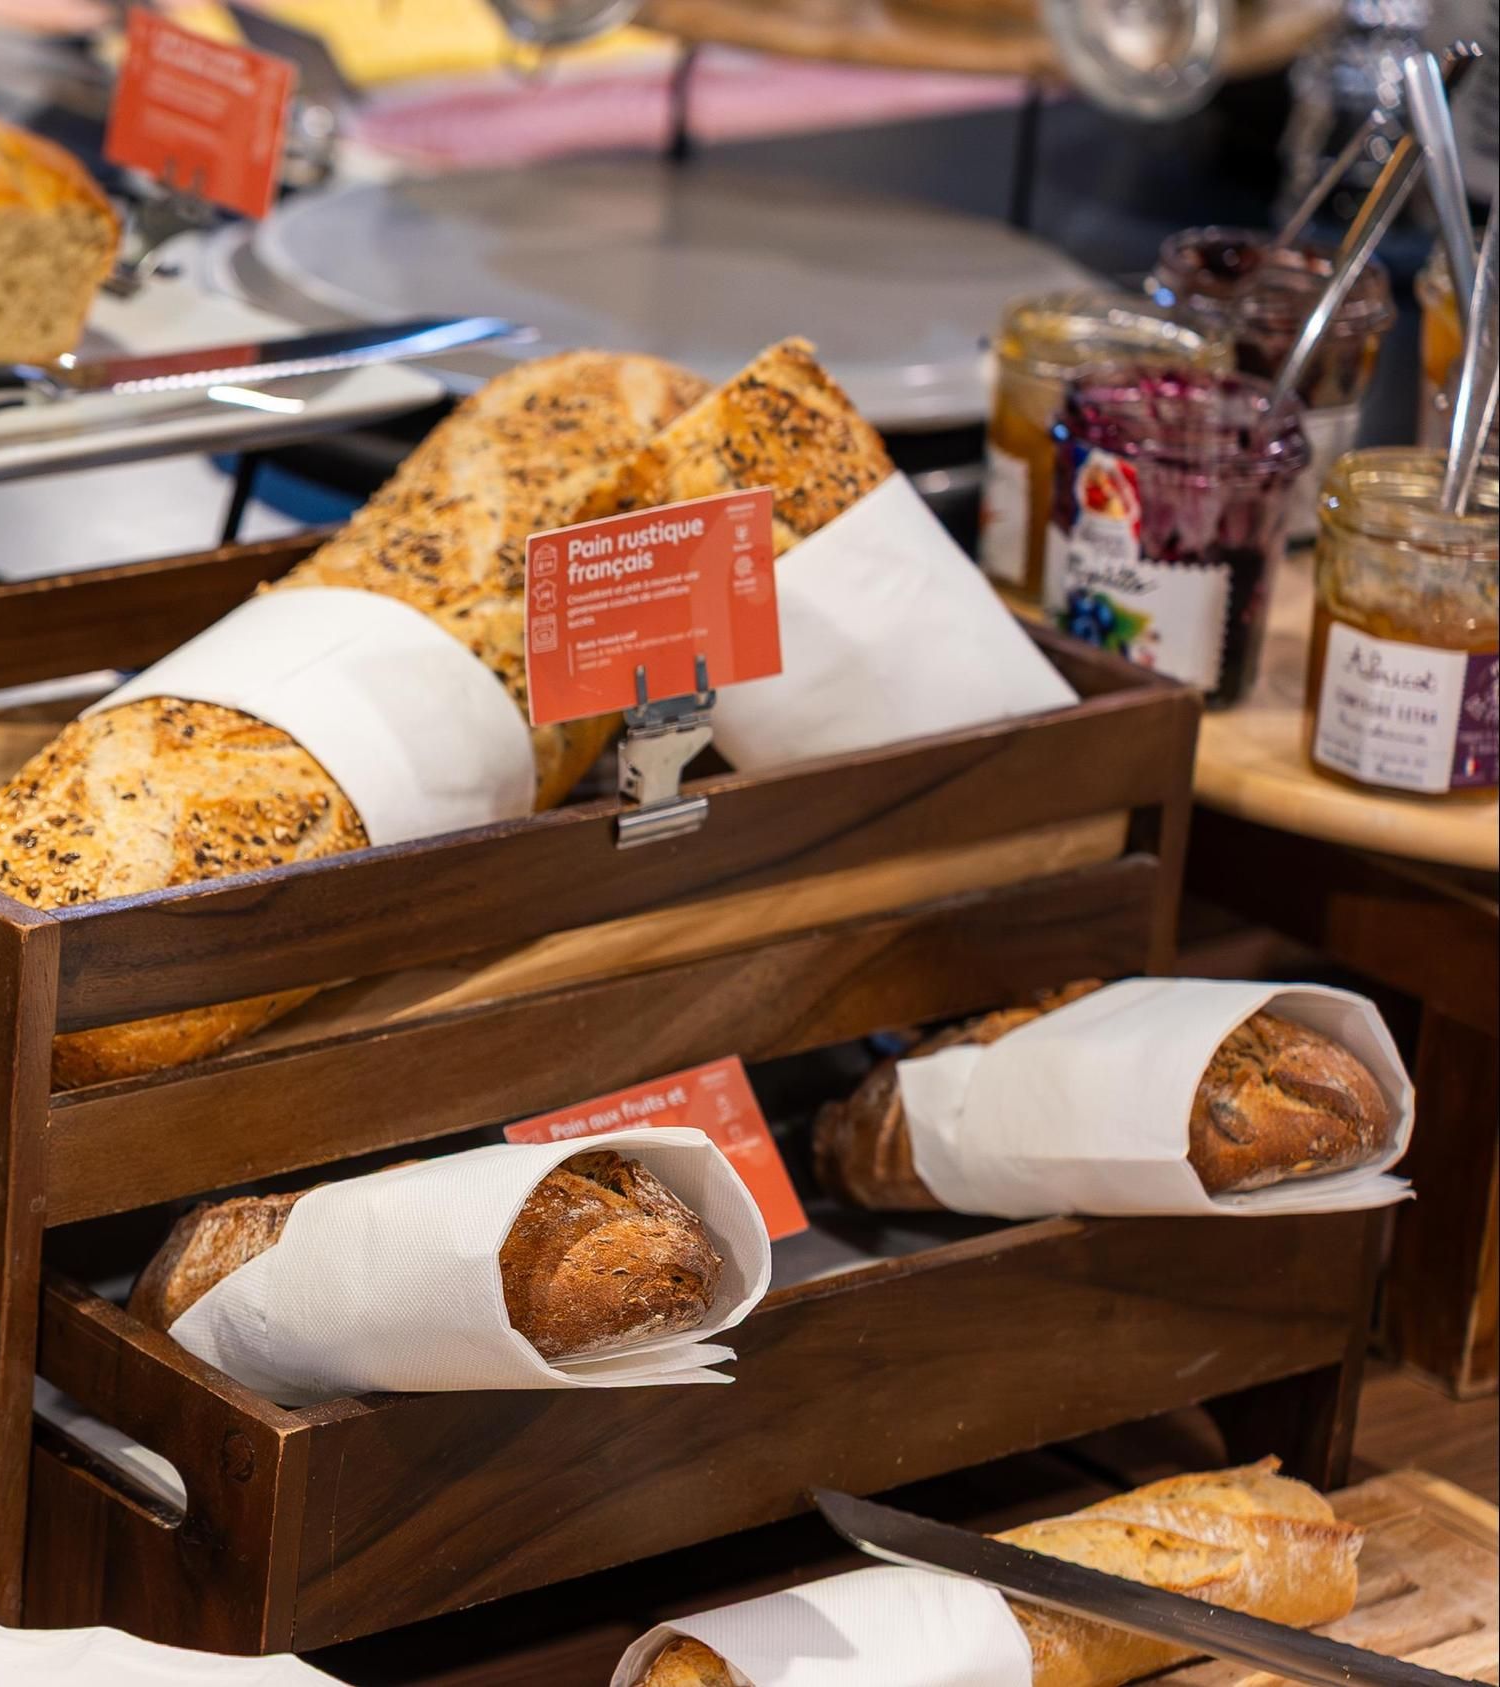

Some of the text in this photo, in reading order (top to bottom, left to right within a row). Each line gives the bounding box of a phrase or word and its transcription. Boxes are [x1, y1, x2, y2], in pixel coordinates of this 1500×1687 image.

[568, 517, 705, 561] Pain rustique
[567, 551, 654, 586] français
[550, 1119, 587, 1140] Pain
[589, 1109, 620, 1129] aux
[619, 1095, 666, 1119] fruits
[667, 1086, 687, 1106] et
